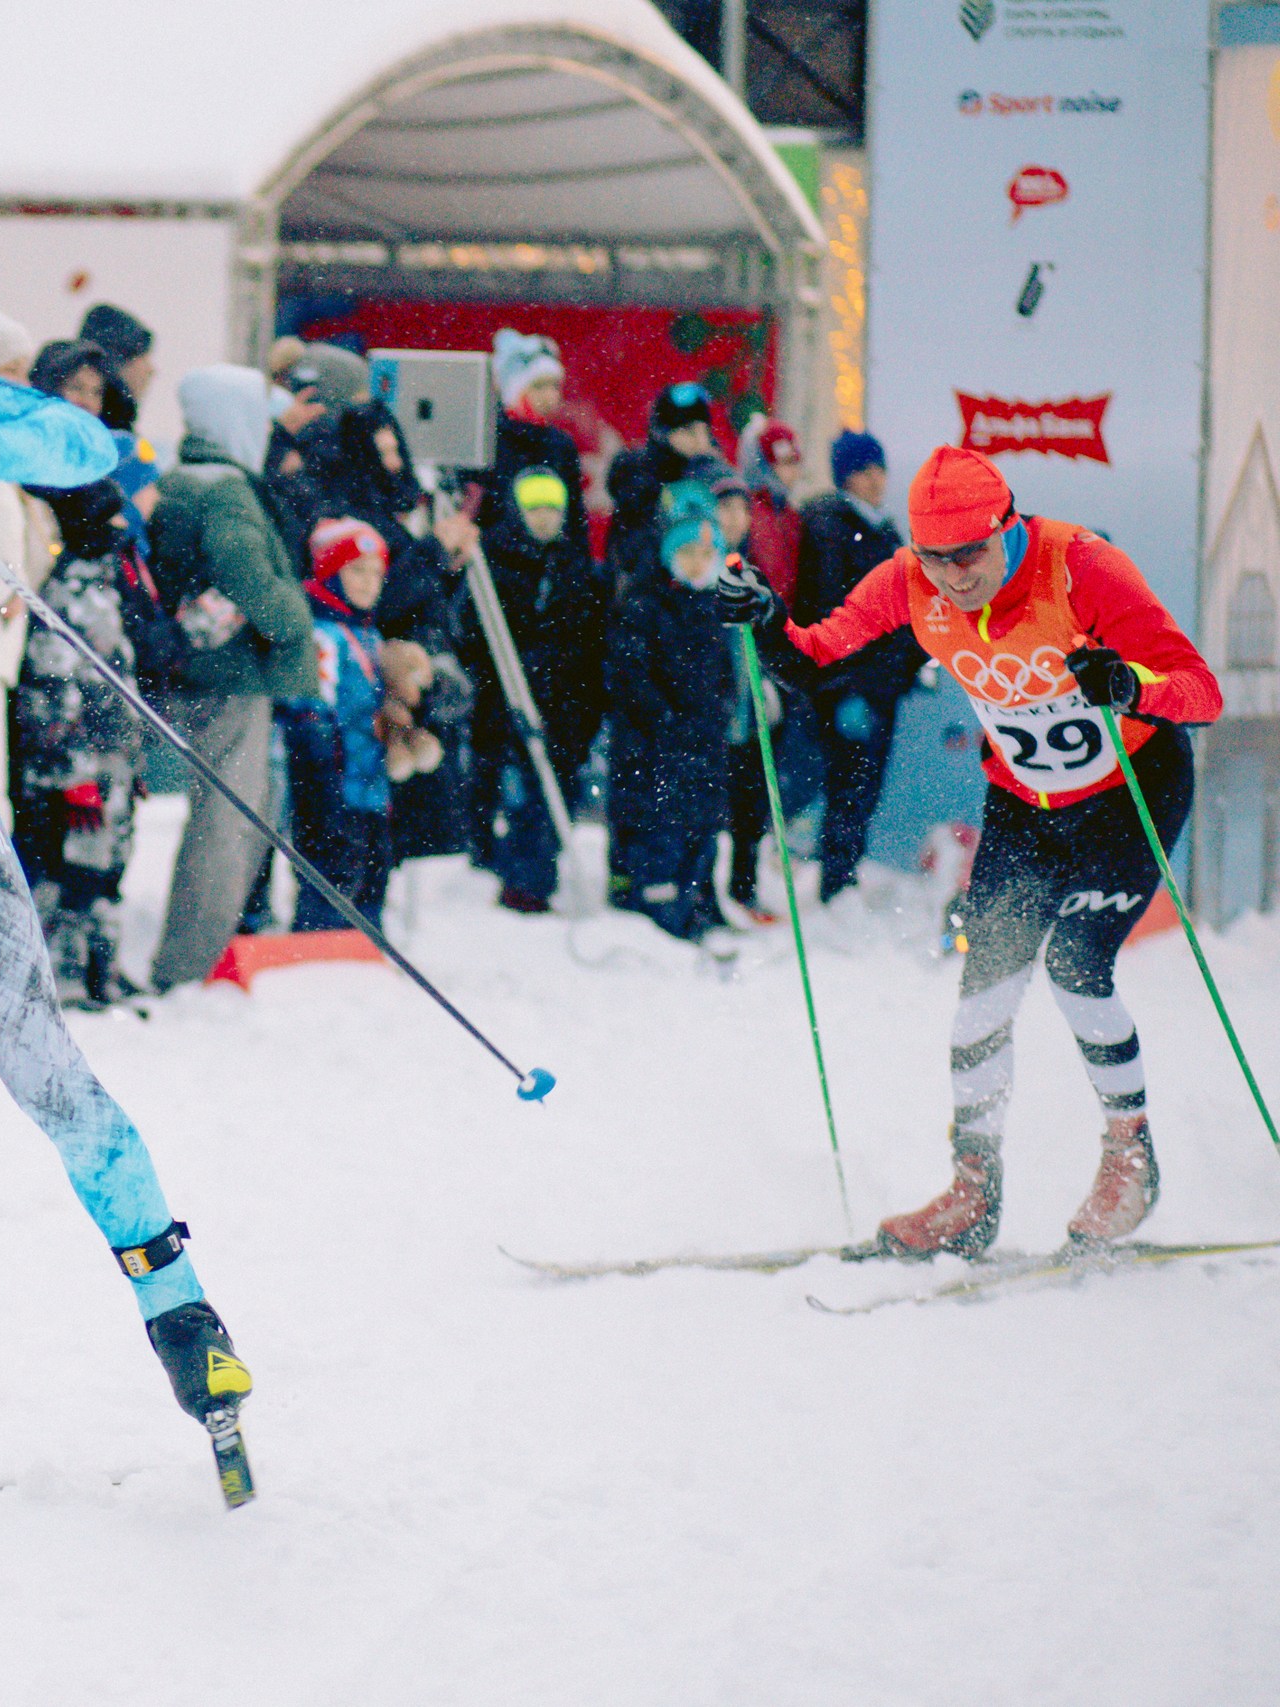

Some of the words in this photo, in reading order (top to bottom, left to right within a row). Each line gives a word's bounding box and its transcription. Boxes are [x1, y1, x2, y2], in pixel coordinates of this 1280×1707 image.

[988, 93, 1054, 117] Sport
[1058, 90, 1123, 113] noise
[995, 717, 1103, 772] 29
